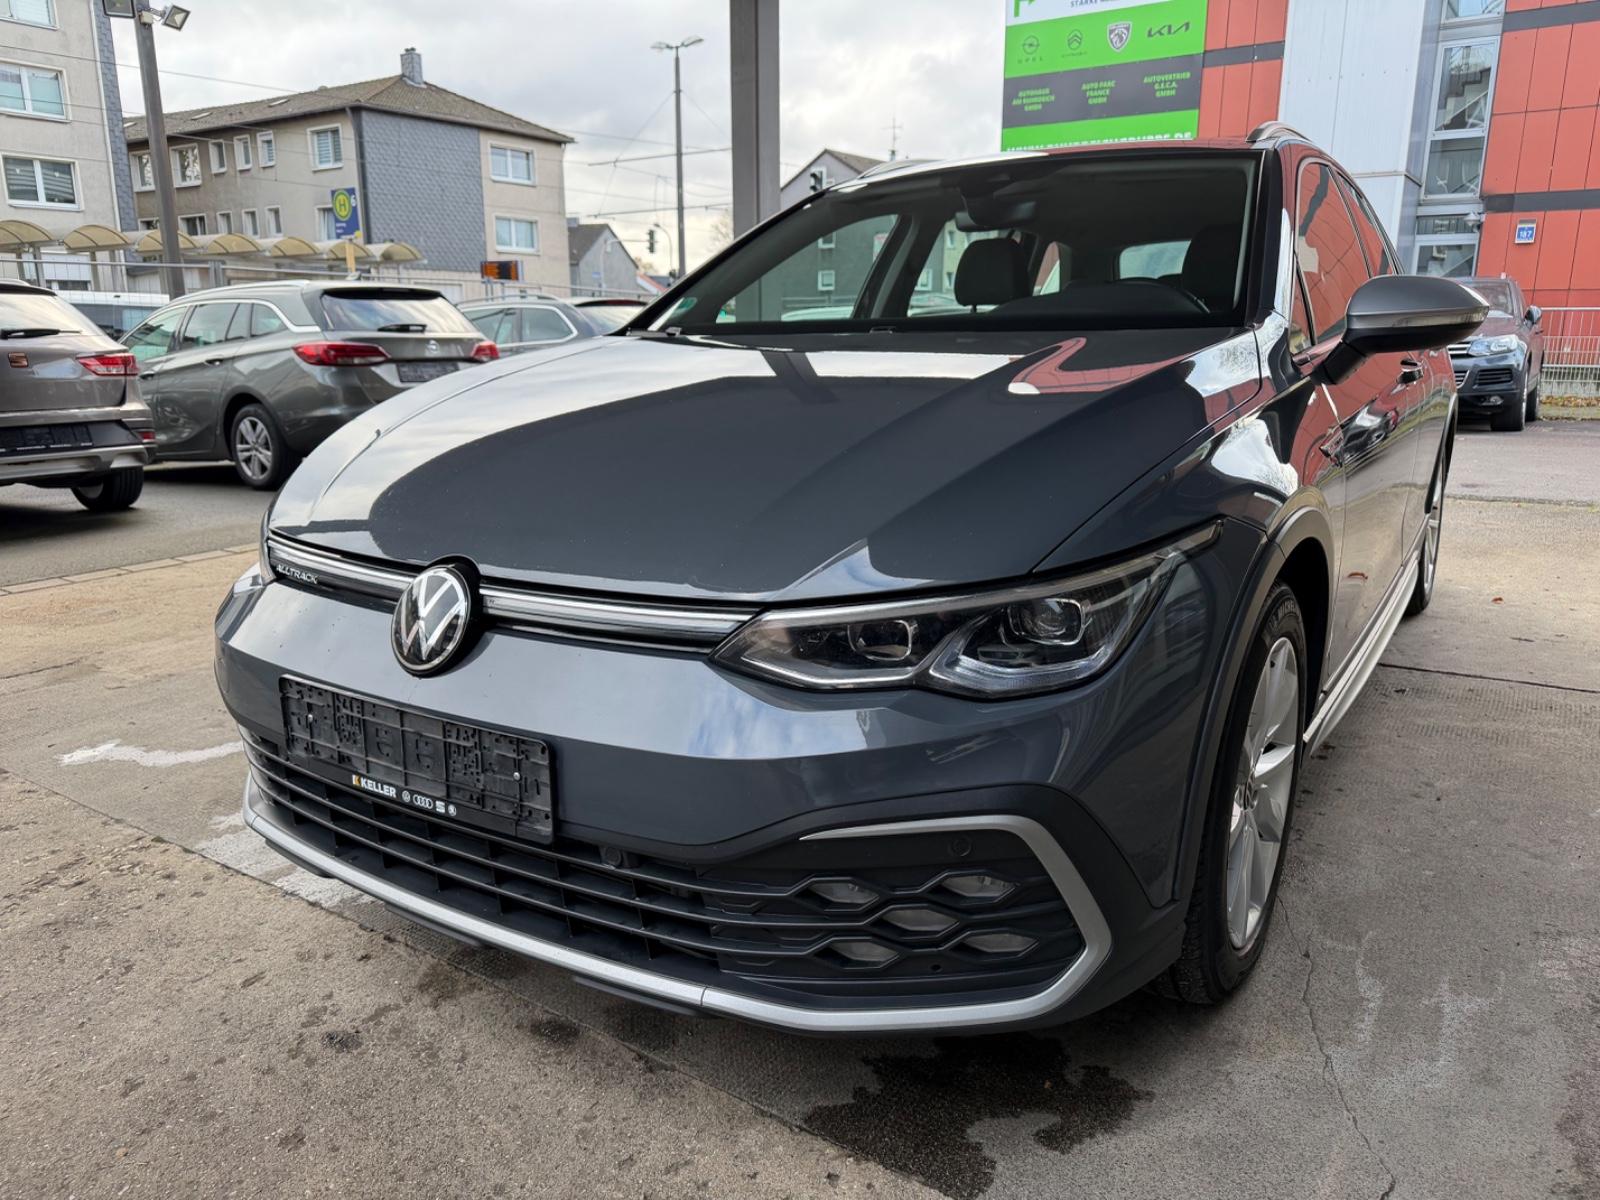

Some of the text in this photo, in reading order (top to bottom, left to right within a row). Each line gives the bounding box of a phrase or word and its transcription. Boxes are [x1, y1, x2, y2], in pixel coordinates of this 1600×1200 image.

[1147, 21, 1191, 38] KIA
[1143, 71, 1191, 83] AUTOVERTRIEB
[1086, 89, 1109, 97] FRANCE
[276, 564, 318, 585] ALLTRACK
[360, 777, 397, 799] KELLER
